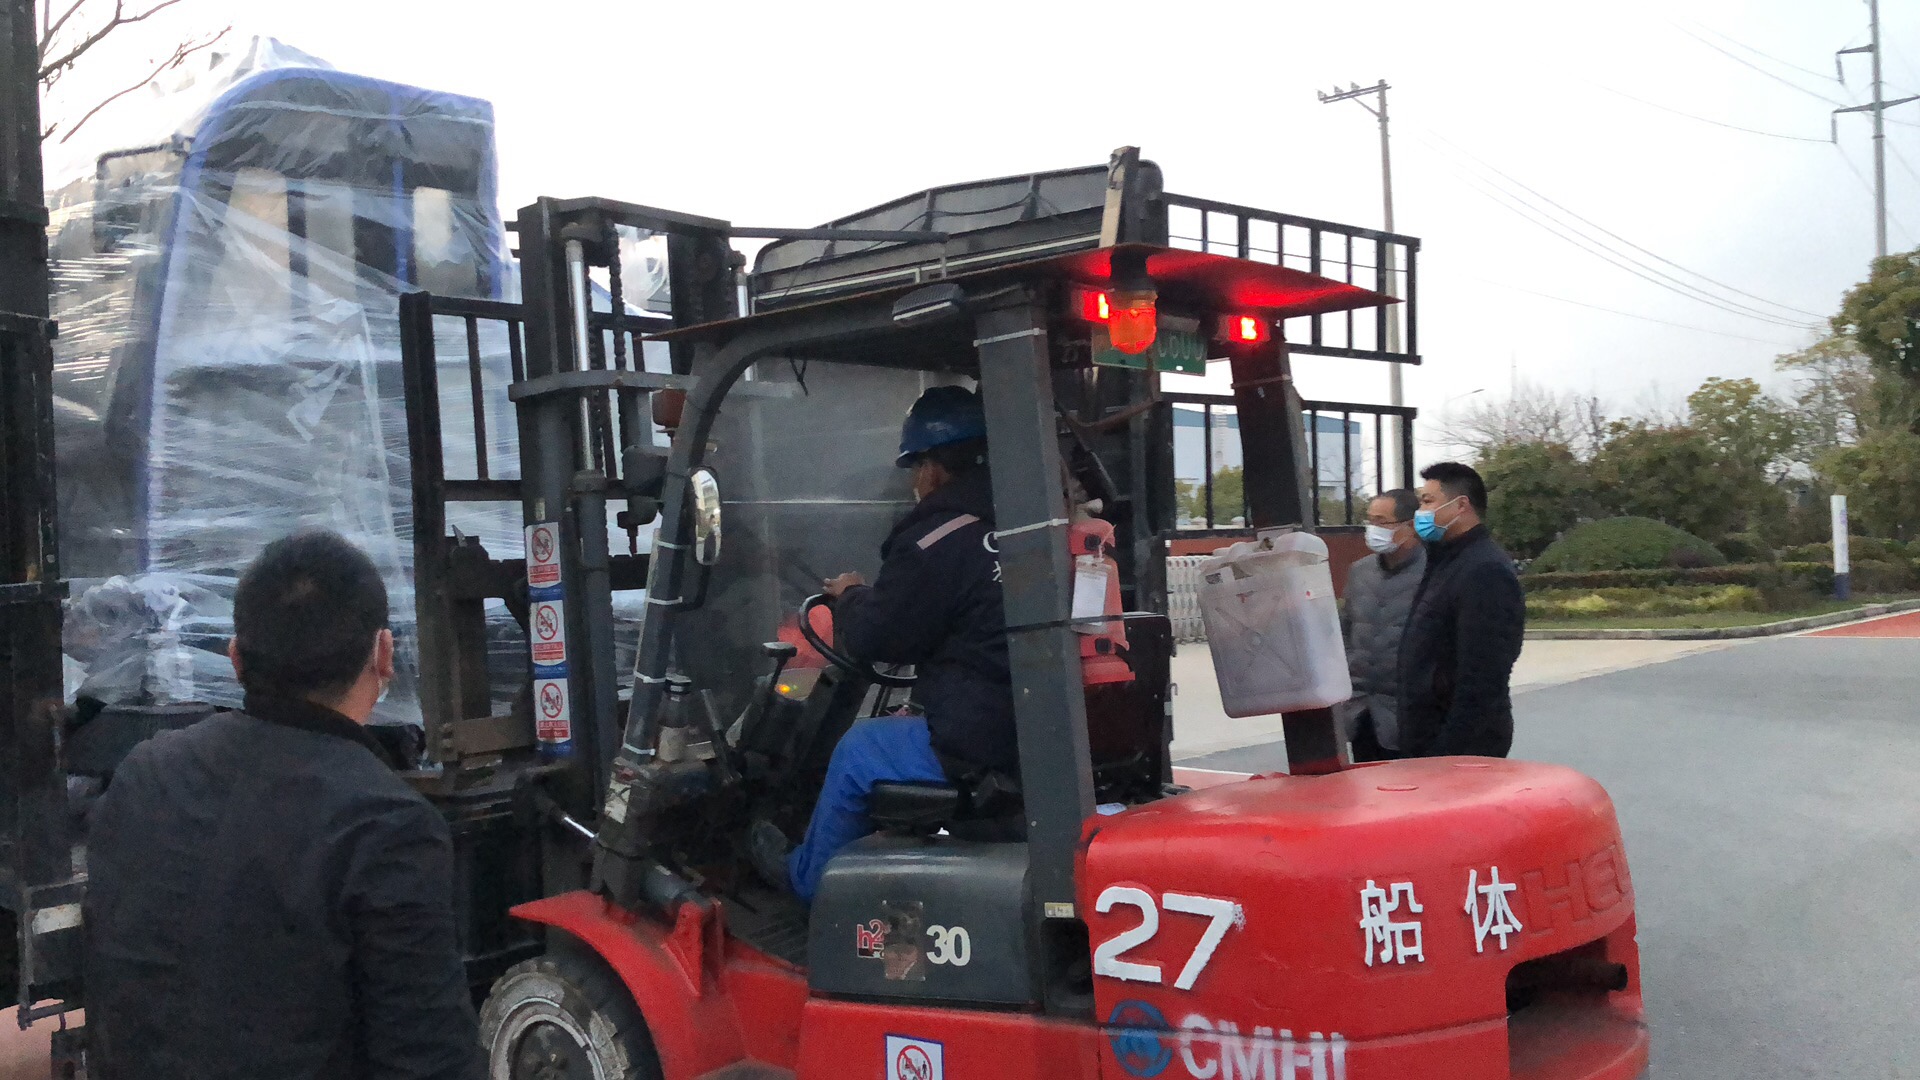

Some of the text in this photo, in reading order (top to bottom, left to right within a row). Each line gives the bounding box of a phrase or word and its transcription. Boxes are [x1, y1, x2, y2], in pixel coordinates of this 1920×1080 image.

[926, 924, 971, 966] 30
[1094, 885, 1246, 991] 27
[1179, 1013, 1347, 1080] CMHI
